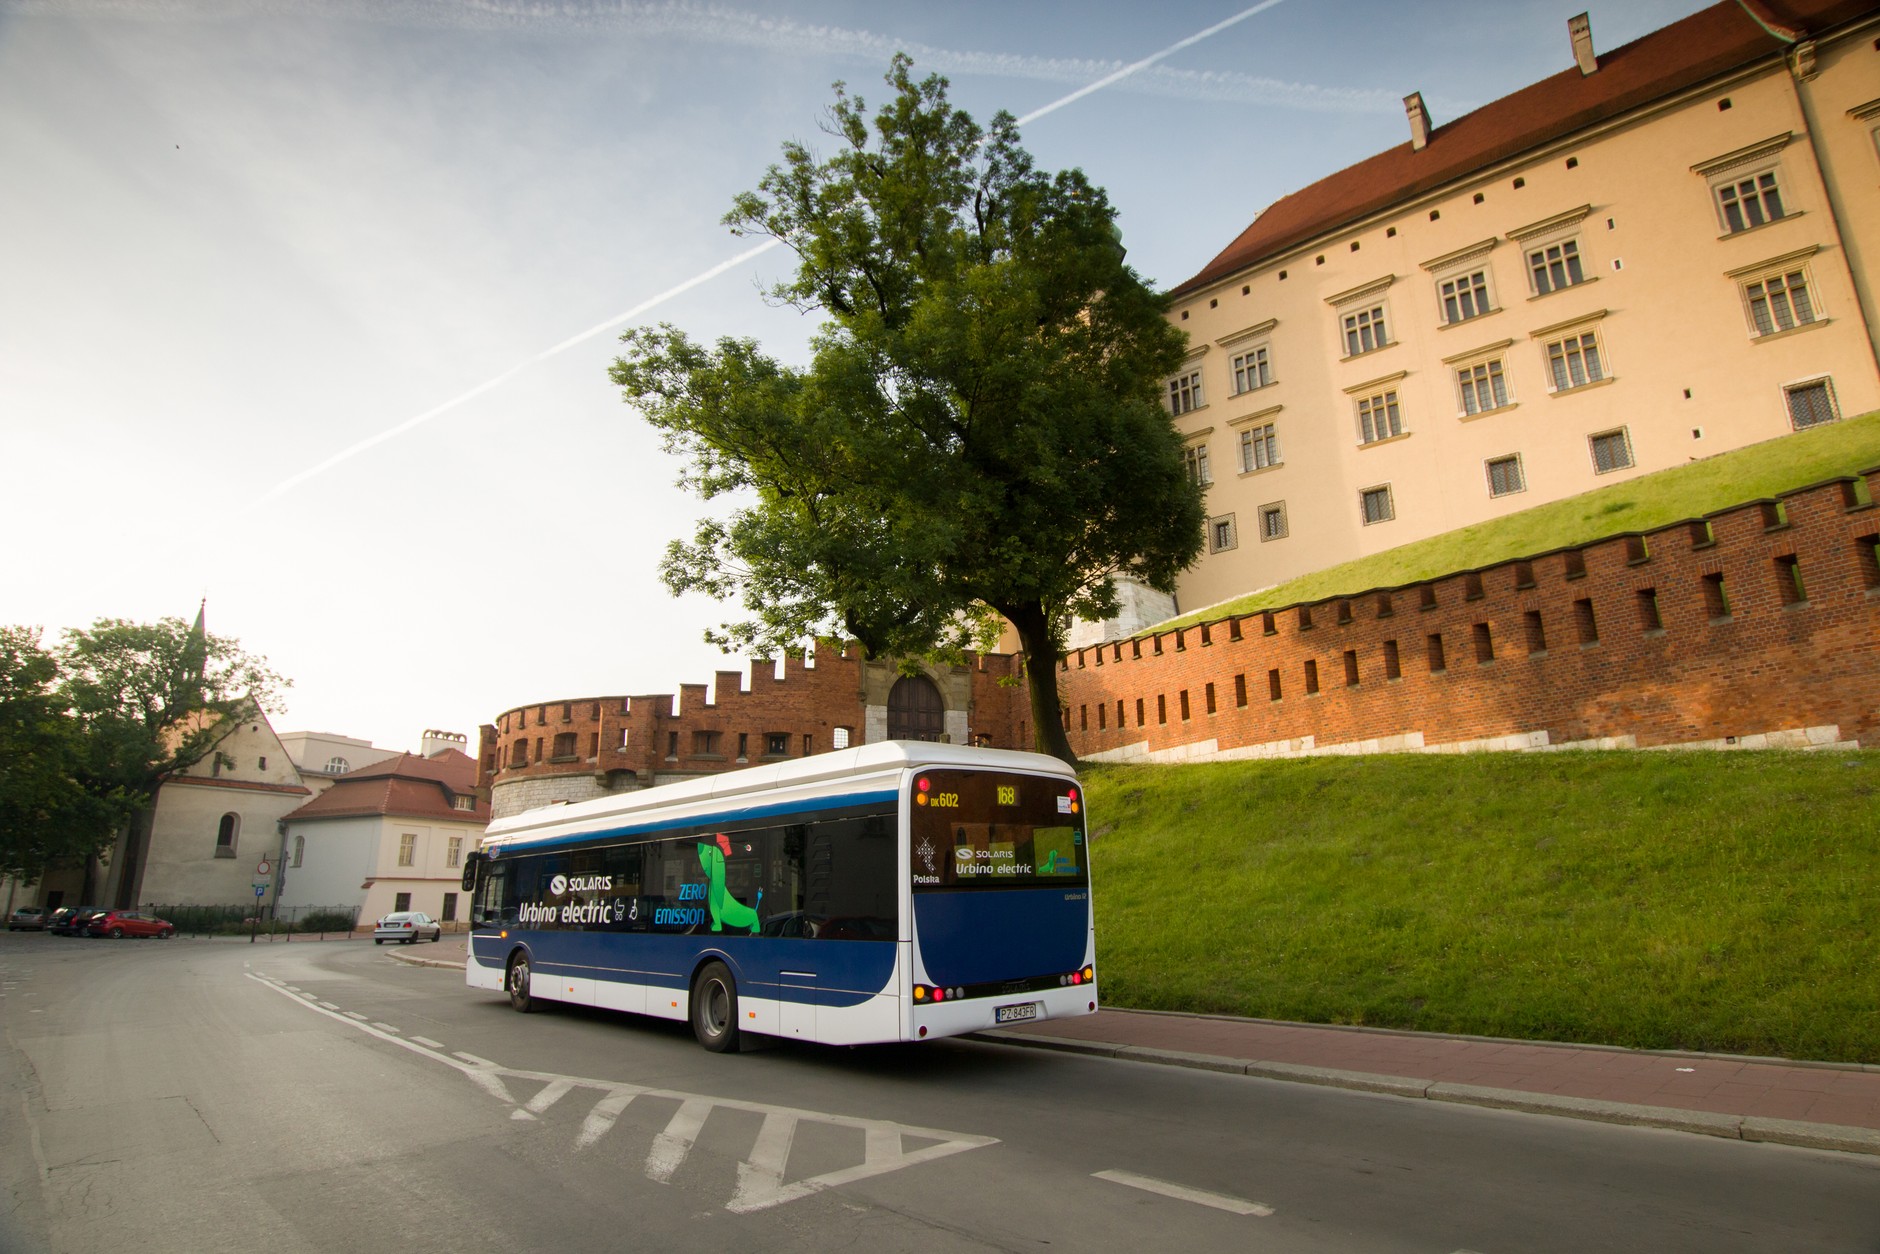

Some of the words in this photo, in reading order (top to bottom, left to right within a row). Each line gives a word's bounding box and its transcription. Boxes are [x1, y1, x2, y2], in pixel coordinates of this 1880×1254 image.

[997, 786, 1015, 804] 168
[976, 850, 1013, 858] SOLARIS
[956, 864, 994, 874] Urbino
[997, 864, 1032, 874] electric
[569, 876, 612, 891] SOLARIS
[913, 874, 940, 884] Polska
[678, 883, 707, 900] ZERO
[519, 901, 556, 922] Urbino
[561, 899, 612, 923] electric
[1001, 1009, 1011, 1019] PZ
[1013, 1006, 1035, 1018] 843FR
